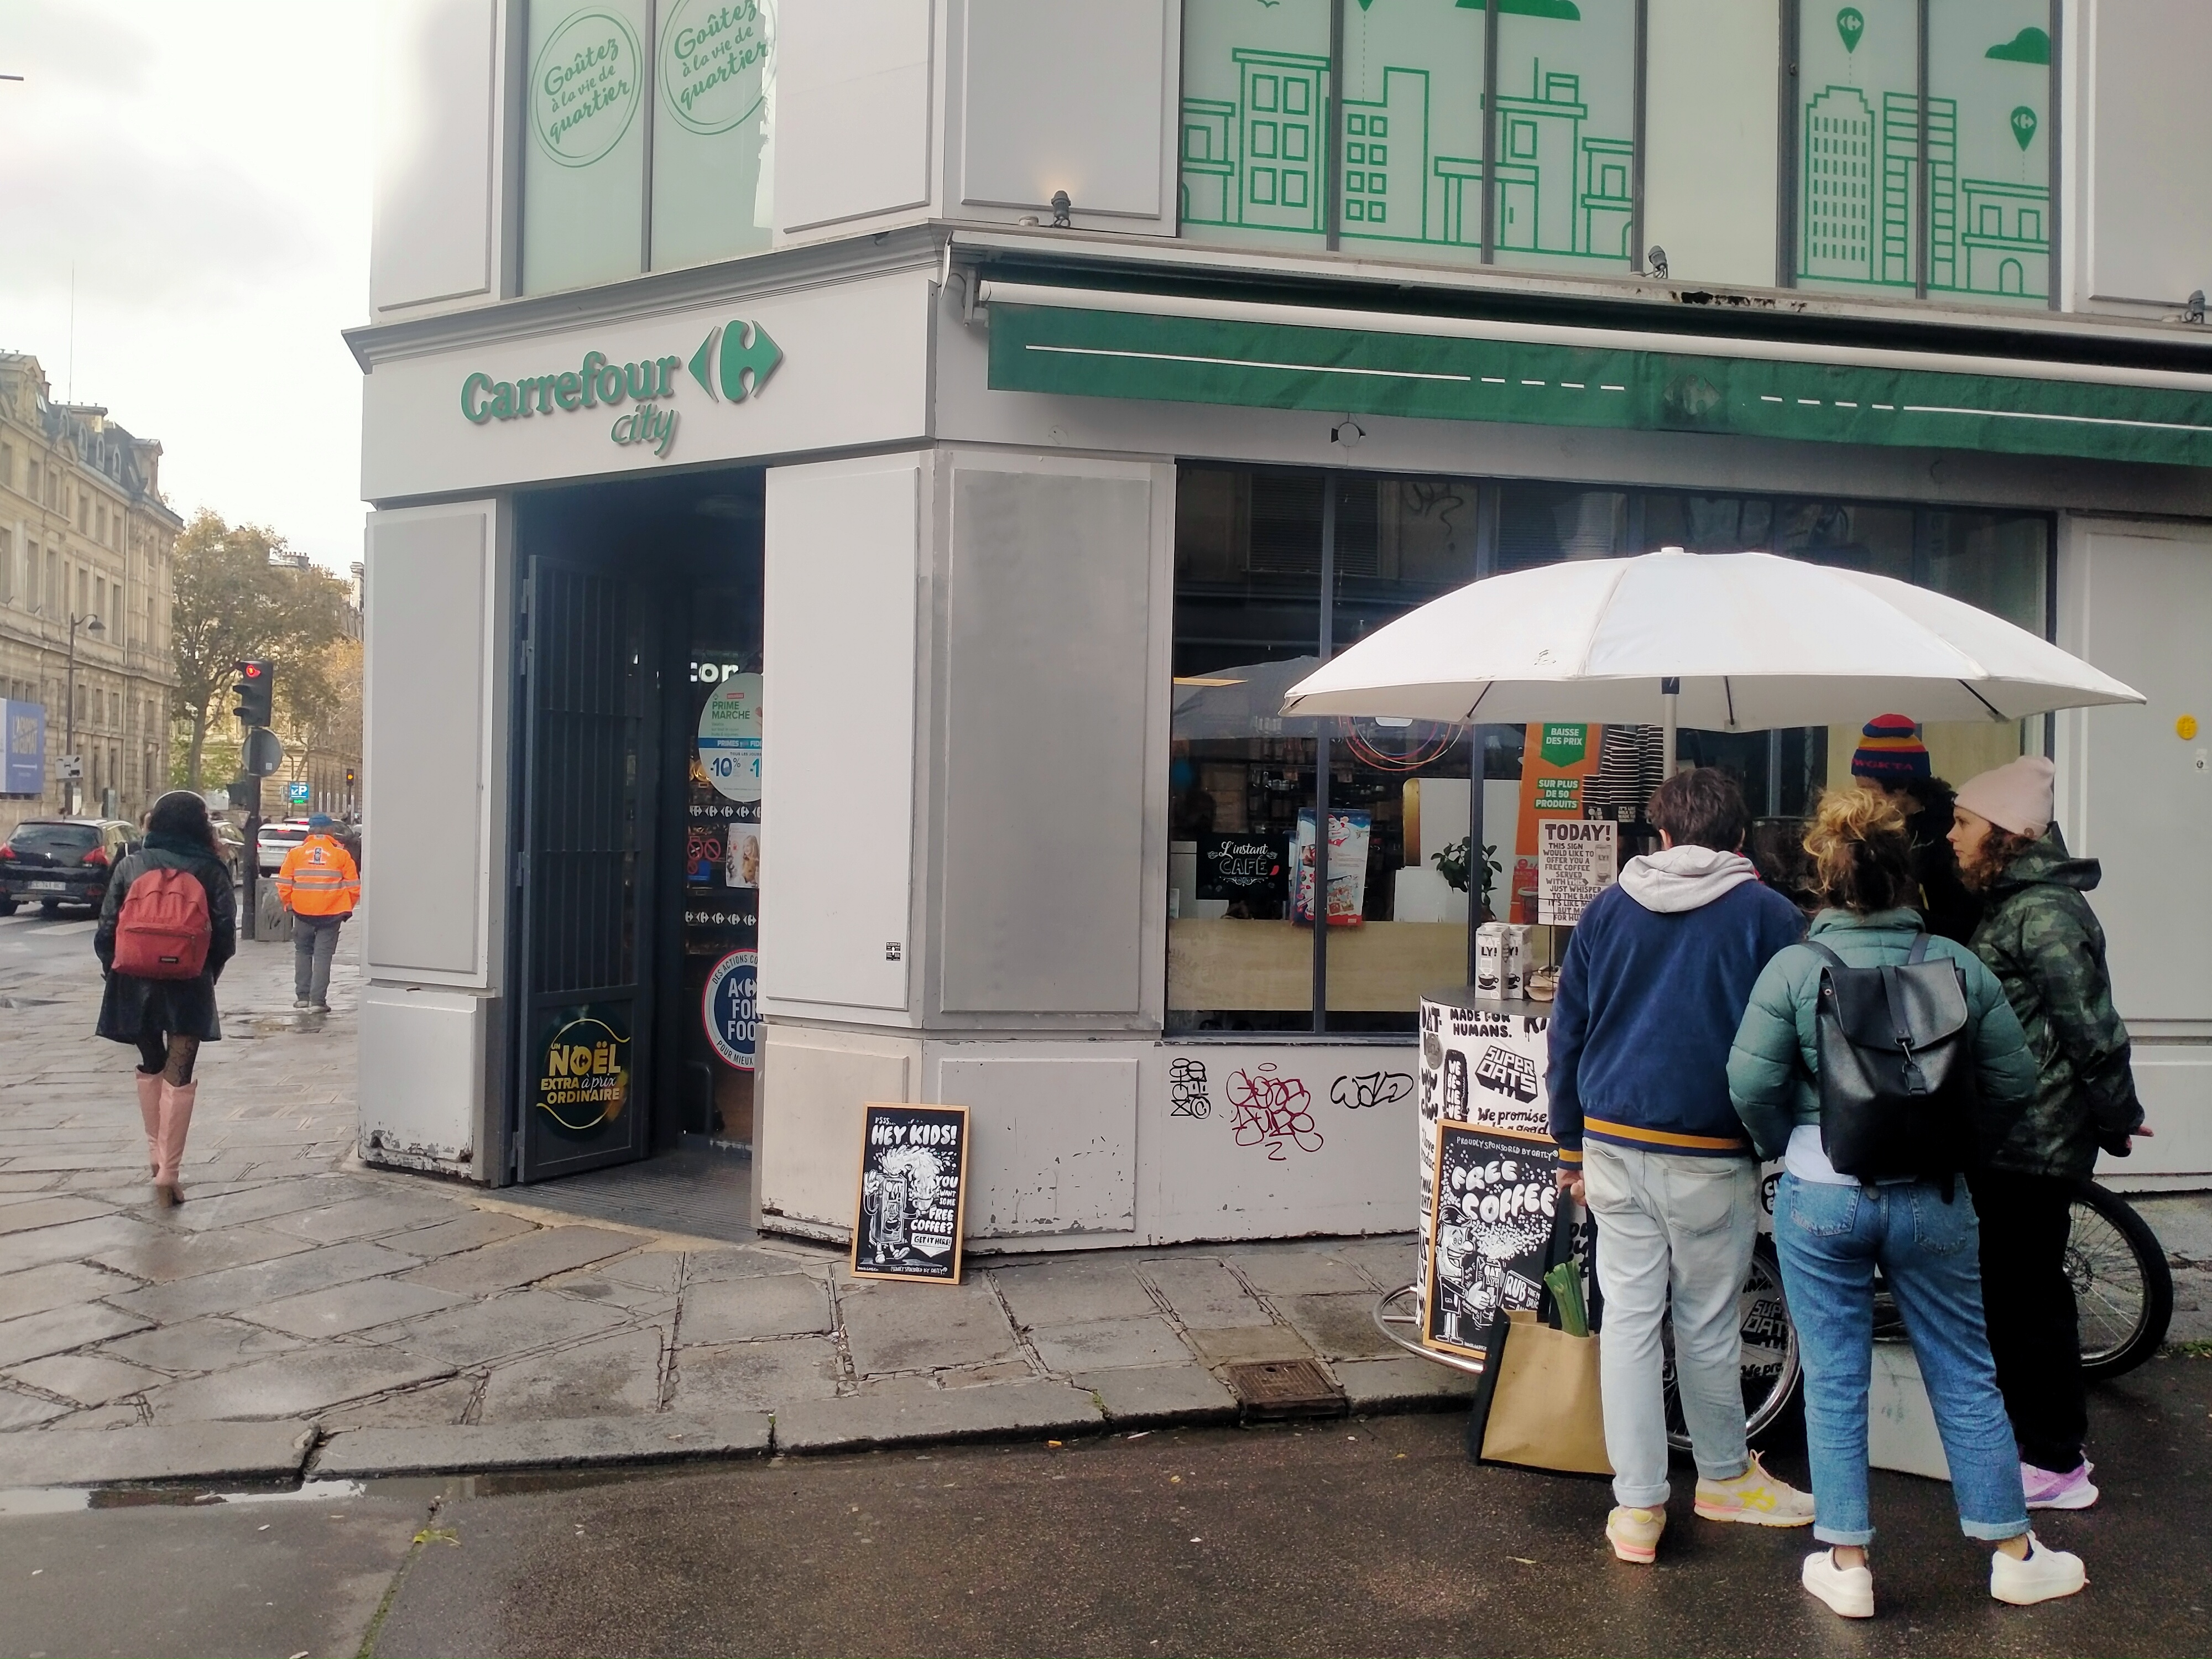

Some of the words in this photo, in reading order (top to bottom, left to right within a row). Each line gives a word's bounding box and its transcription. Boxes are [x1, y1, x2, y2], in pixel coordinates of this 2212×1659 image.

[675, 0, 757, 59] Goûtez
[683, 62, 692, 77] à
[693, 55, 709, 70] la
[712, 42, 732, 59] vie
[735, 27, 754, 44] de
[545, 39, 618, 96] Goûtez
[681, 41, 768, 110] quartier
[552, 98, 559, 112] à
[562, 91, 576, 107] la
[578, 79, 596, 95] vie
[599, 65, 615, 82] de
[550, 79, 630, 144] quartier
[461, 351, 681, 424] Carrefour
[611, 403, 680, 457] city
[712, 701, 739, 710] PRIME
[712, 708, 750, 719] MARCHÉ
[1551, 728, 1579, 736] BAISSE
[1545, 824, 1611, 841] TODAY!
[1219, 841, 1268, 859] L'instant
[1219, 854, 1267, 875] CAFÉ
[1481, 947, 1498, 957] LY!
[1509, 946, 1519, 956] Y!
[712, 970, 723, 984] DES
[723, 954, 748, 972] ACTIONS
[1450, 1008, 1481, 1022] MADE
[1453, 1023, 1512, 1038] HUMANS.
[549, 1041, 621, 1076] NOËL
[717, 1040, 732, 1059] POUR
[733, 1054, 753, 1065] MIEUX
[1484, 1046, 1535, 1076] SUPER
[1448, 1060, 1462, 1076] WE
[1476, 1060, 1537, 1095] OATS
[541, 1077, 580, 1091] EXTRA
[581, 1073, 591, 1089] à
[589, 1073, 616, 1093] prix
[547, 1088, 620, 1104] ORDINAIRE
[1447, 1089, 1461, 1105] LIE
[1477, 1107, 1495, 1121] We
[1497, 1109, 1547, 1124] promise
[872, 1124, 907, 1145] HEY
[910, 1124, 957, 1145] KIDS!
[1457, 1136, 1484, 1149] PROUDLY
[1484, 1142, 1520, 1154] SPONSORED
[1531, 1150, 1552, 1161] OATLY
[936, 1175, 958, 1188] YOU
[1451, 1160, 1517, 1191] FREE
[940, 1189, 957, 1197] WANT
[940, 1197, 956, 1207] SOME
[1462, 1183, 1556, 1223] COFFEE
[929, 1208, 954, 1222] FREE
[911, 1219, 953, 1234] COFFEE?
[935, 1237, 951, 1246] HERE!
[1505, 1276, 1527, 1302] RUB
